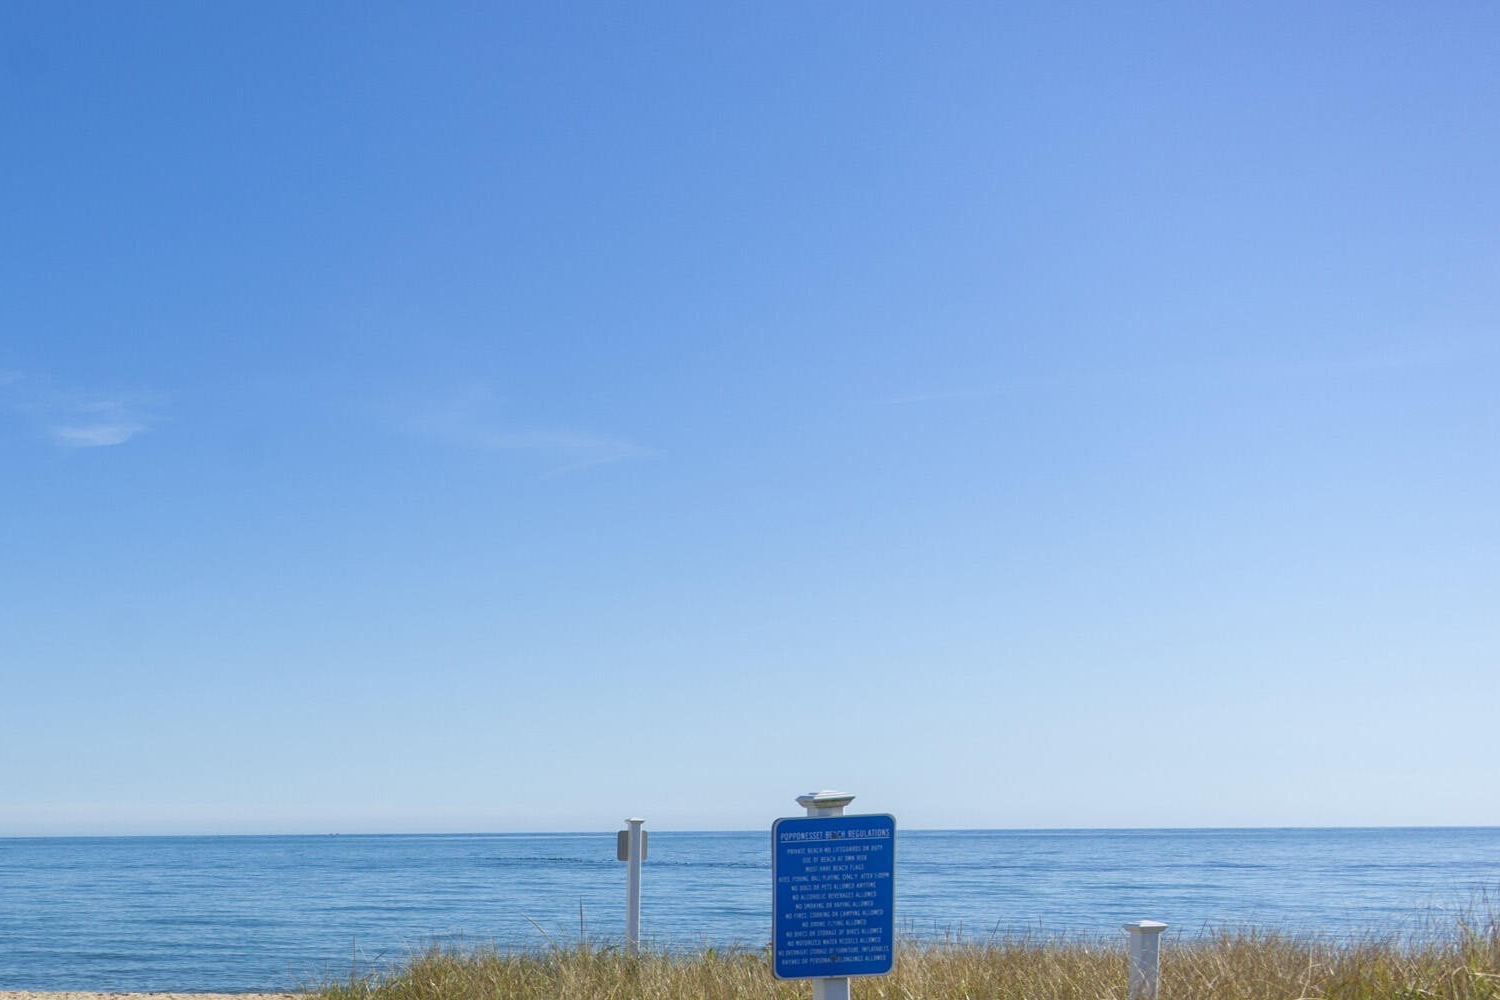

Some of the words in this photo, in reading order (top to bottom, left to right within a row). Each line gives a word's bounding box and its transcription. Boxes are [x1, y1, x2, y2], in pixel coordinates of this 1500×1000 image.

[780, 831, 823, 840] POPPONESSET
[825, 830, 845, 839] BECH
[848, 829, 890, 838] REGULATIONS
